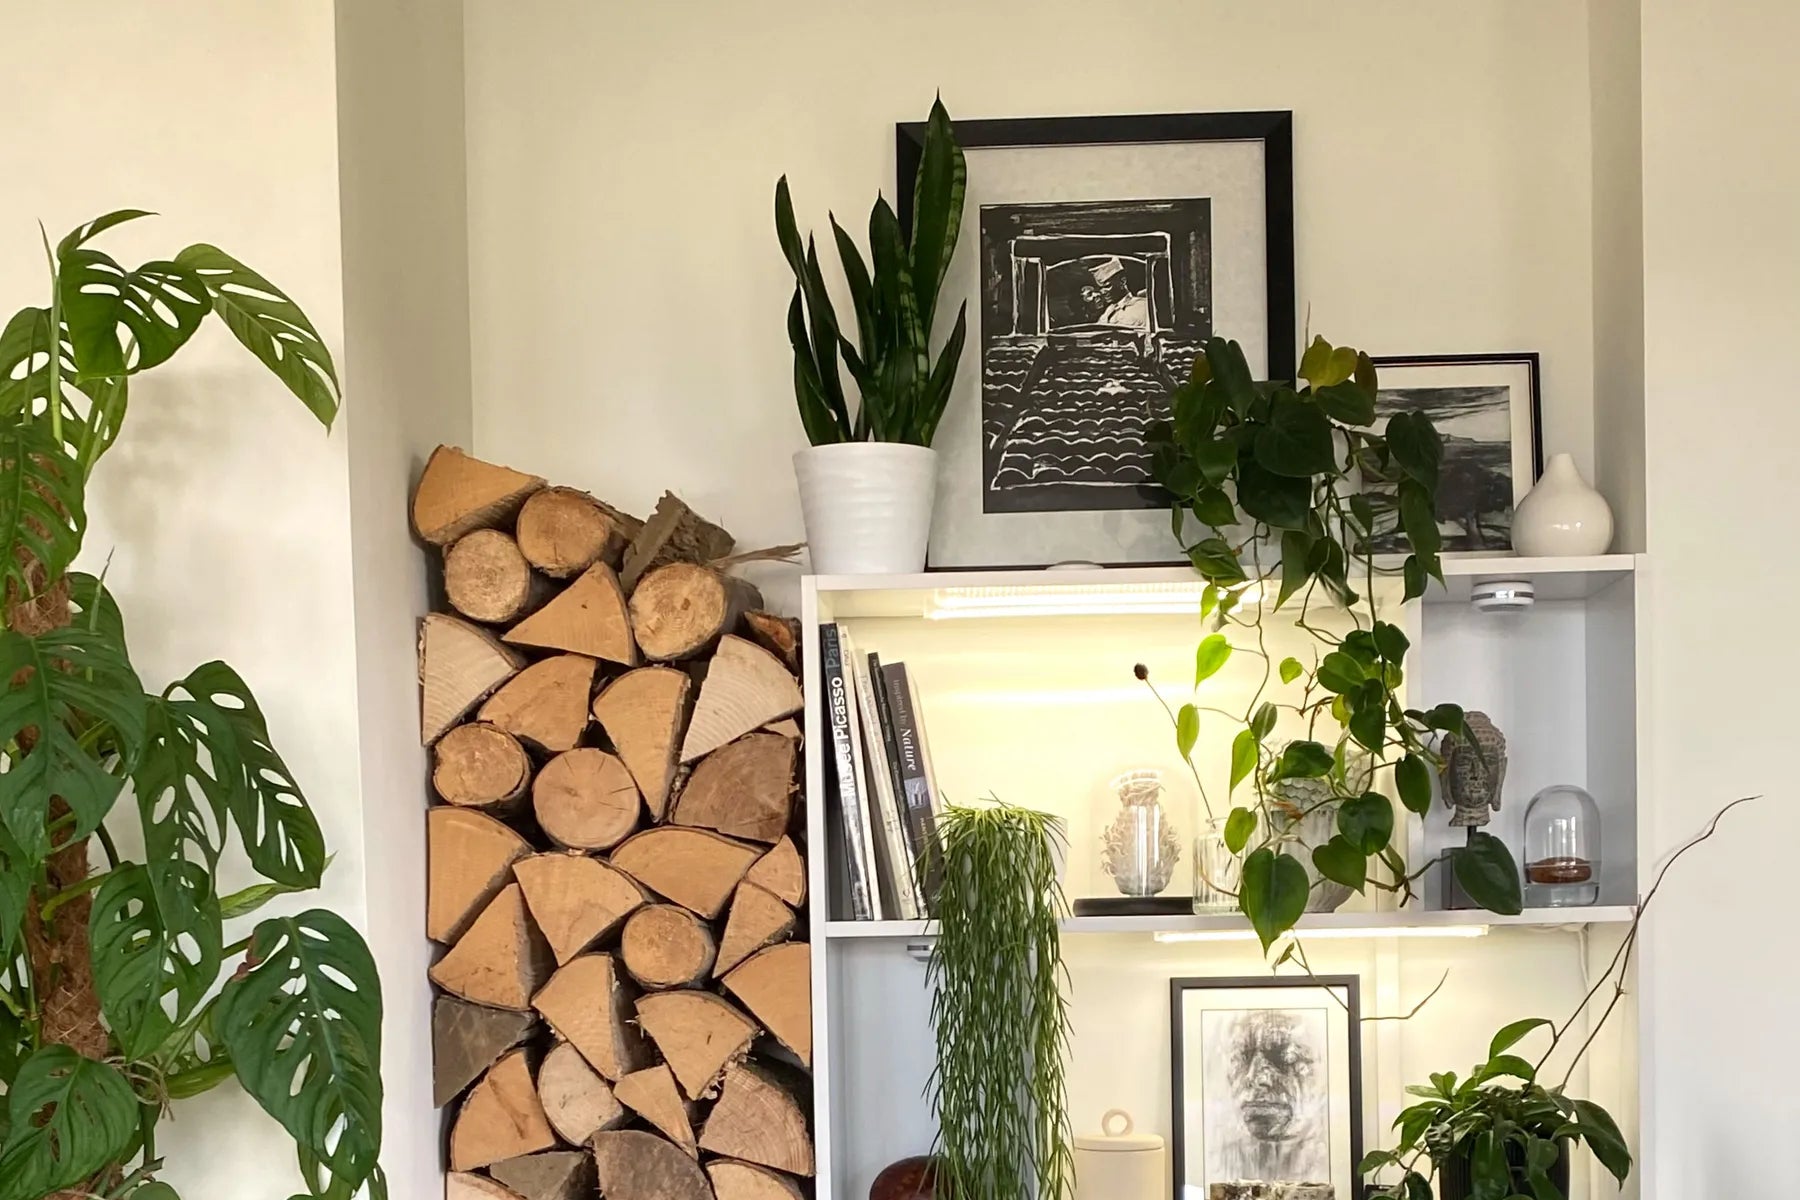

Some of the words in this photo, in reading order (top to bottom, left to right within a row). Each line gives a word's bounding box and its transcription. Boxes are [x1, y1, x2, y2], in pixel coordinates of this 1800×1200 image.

[826, 628, 840, 668] Paris
[831, 676, 850, 740] Picasso
[893, 679, 906, 715] Inspired
[901, 727, 917, 771] Nature
